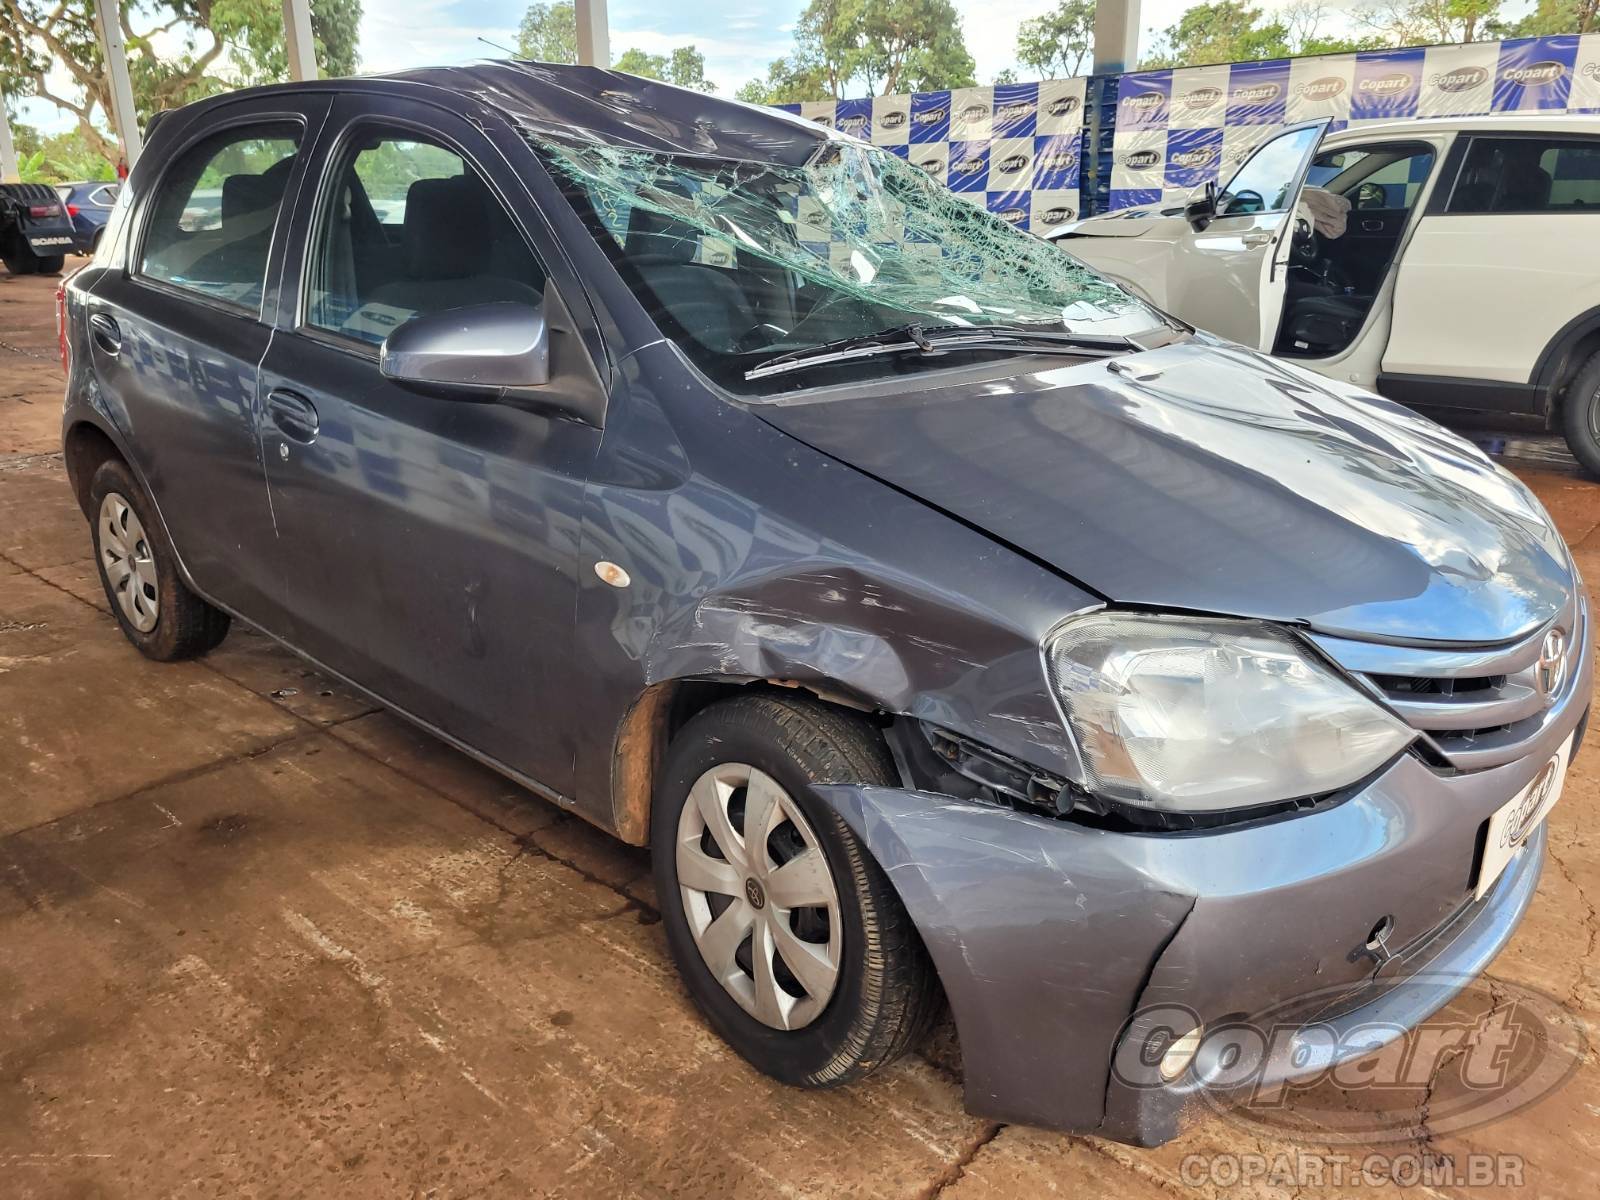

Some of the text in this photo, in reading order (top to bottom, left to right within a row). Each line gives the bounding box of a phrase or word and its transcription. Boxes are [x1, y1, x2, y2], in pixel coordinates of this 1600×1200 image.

[1431, 69, 1479, 89] Copart
[1503, 65, 1555, 85] Copart
[1295, 80, 1339, 97] Copart
[1360, 76, 1408, 93] Copart
[1122, 93, 1160, 108] Copart
[1233, 86, 1275, 101] Copart
[914, 110, 941, 123] Copart
[952, 159, 981, 172] Copart
[1119, 153, 1155, 166] Copart
[1171, 151, 1211, 166] Copart
[1034, 210, 1069, 223] Copart
[31, 237, 73, 246] SCANIA
